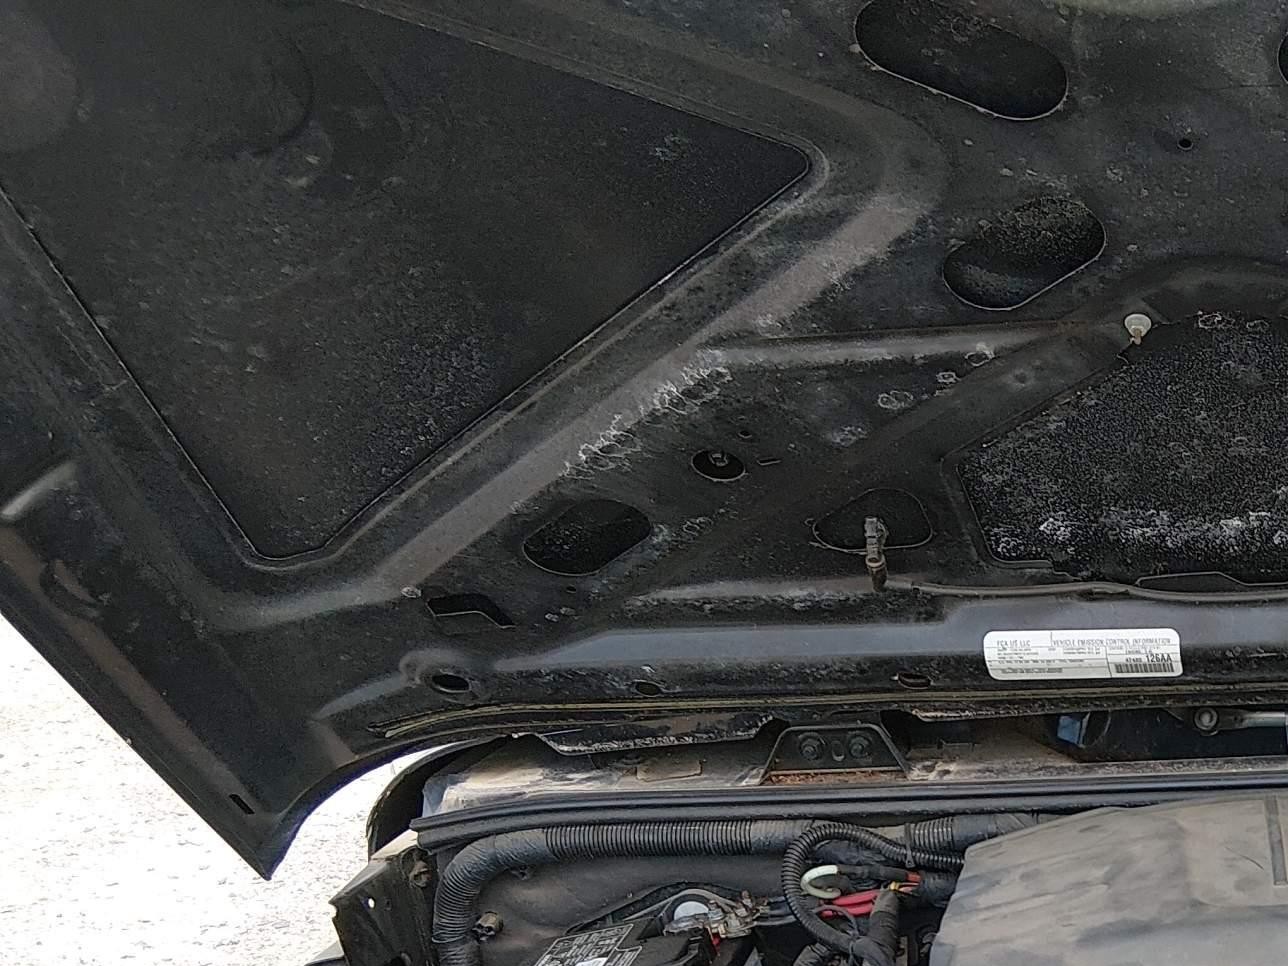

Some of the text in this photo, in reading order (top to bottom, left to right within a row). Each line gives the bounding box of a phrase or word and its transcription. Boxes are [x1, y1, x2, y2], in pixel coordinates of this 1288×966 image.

[1053, 637, 1171, 647] VEHICLE EMISSION CONTROL INFORMATION
[1146, 653, 1172, 663] 126AA
